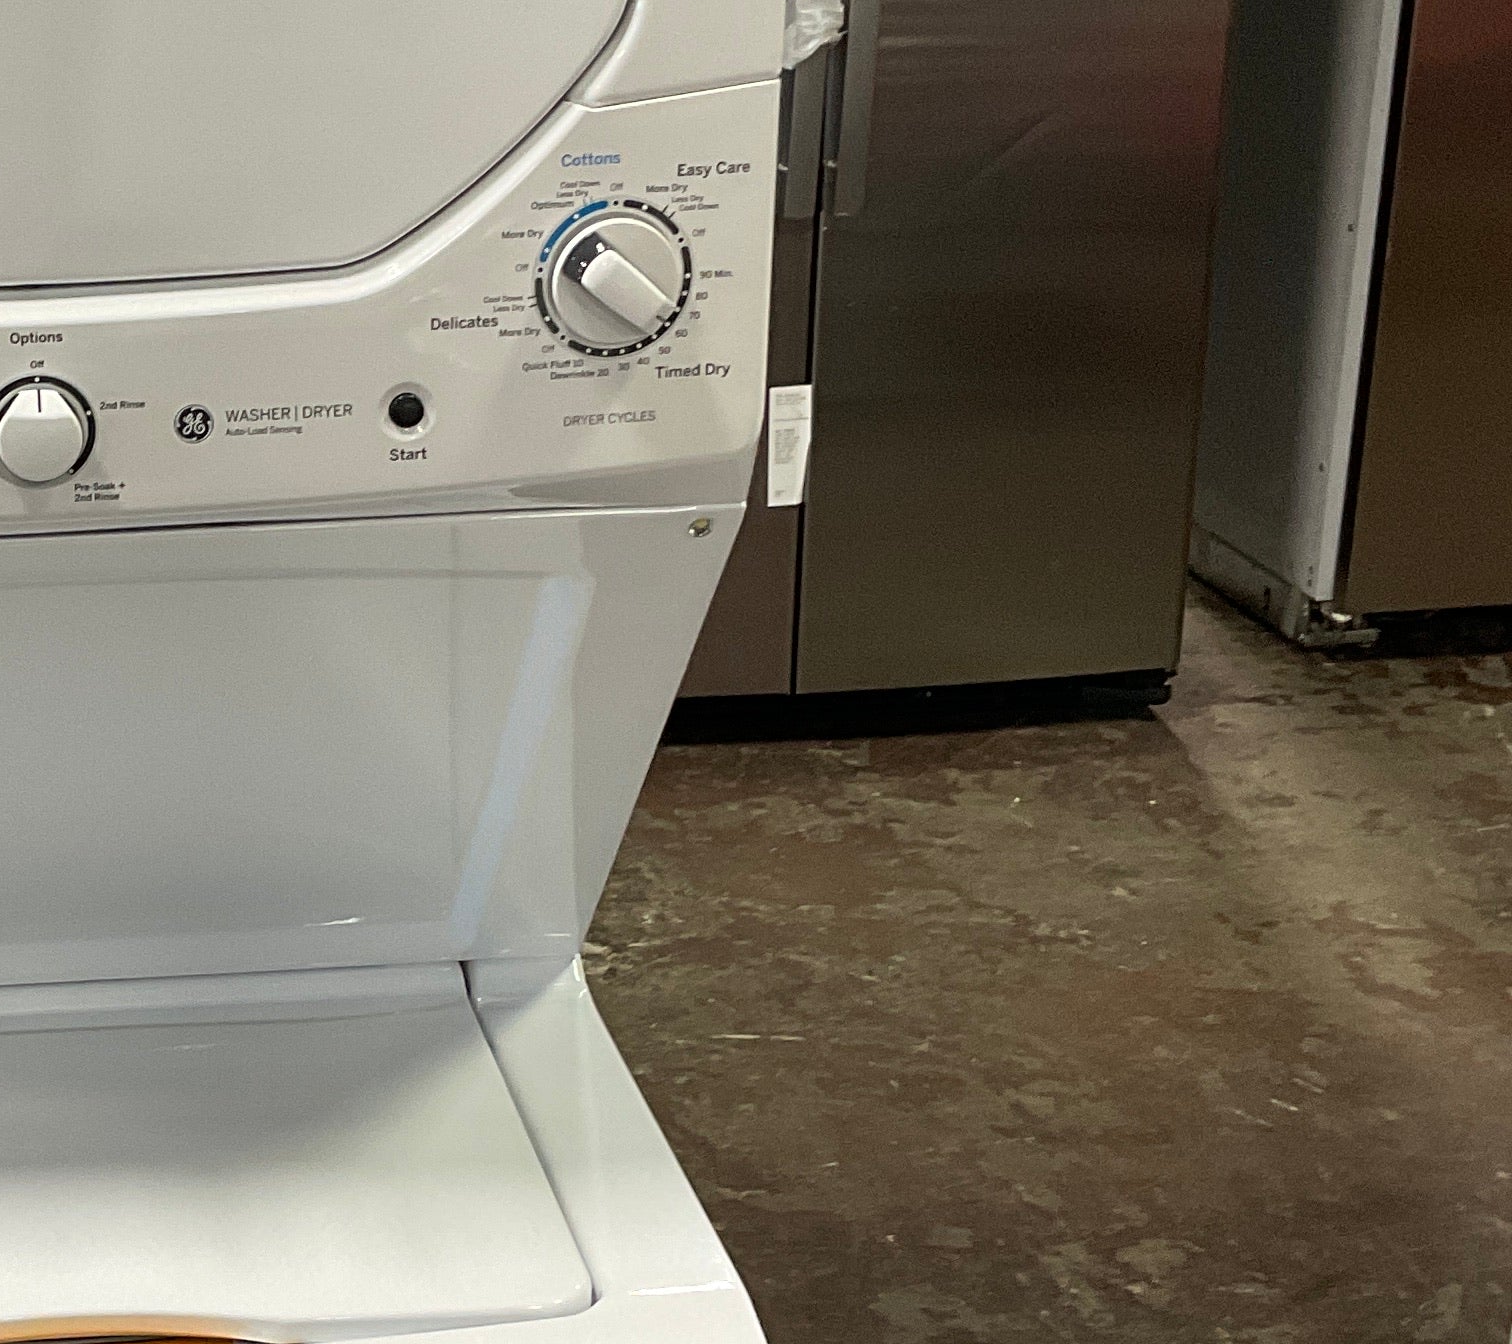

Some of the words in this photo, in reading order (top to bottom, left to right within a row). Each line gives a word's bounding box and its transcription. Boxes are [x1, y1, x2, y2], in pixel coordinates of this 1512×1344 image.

[561, 153, 621, 167] Cottons
[677, 163, 712, 177] Easy
[715, 161, 751, 174] Care
[646, 185, 668, 193] More
[671, 183, 688, 193] Dry
[501, 230, 524, 239] More
[527, 229, 544, 240] Dry
[431, 316, 499, 330] Delicates
[9, 332, 64, 347] Options
[524, 328, 541, 338] Dry
[29, 360, 45, 369] Off
[655, 365, 702, 379] Timed
[705, 363, 731, 378] Dry
[99, 401, 118, 411] 2nd
[119, 400, 146, 409] Rinse
[225, 408, 291, 423] WASHER
[301, 404, 353, 419] DRYER
[563, 414, 605, 427] DRYER
[608, 411, 657, 424] CYCLES
[389, 448, 428, 462] Start
[74, 493, 92, 503] 2nd
[94, 492, 120, 501] Rinse
